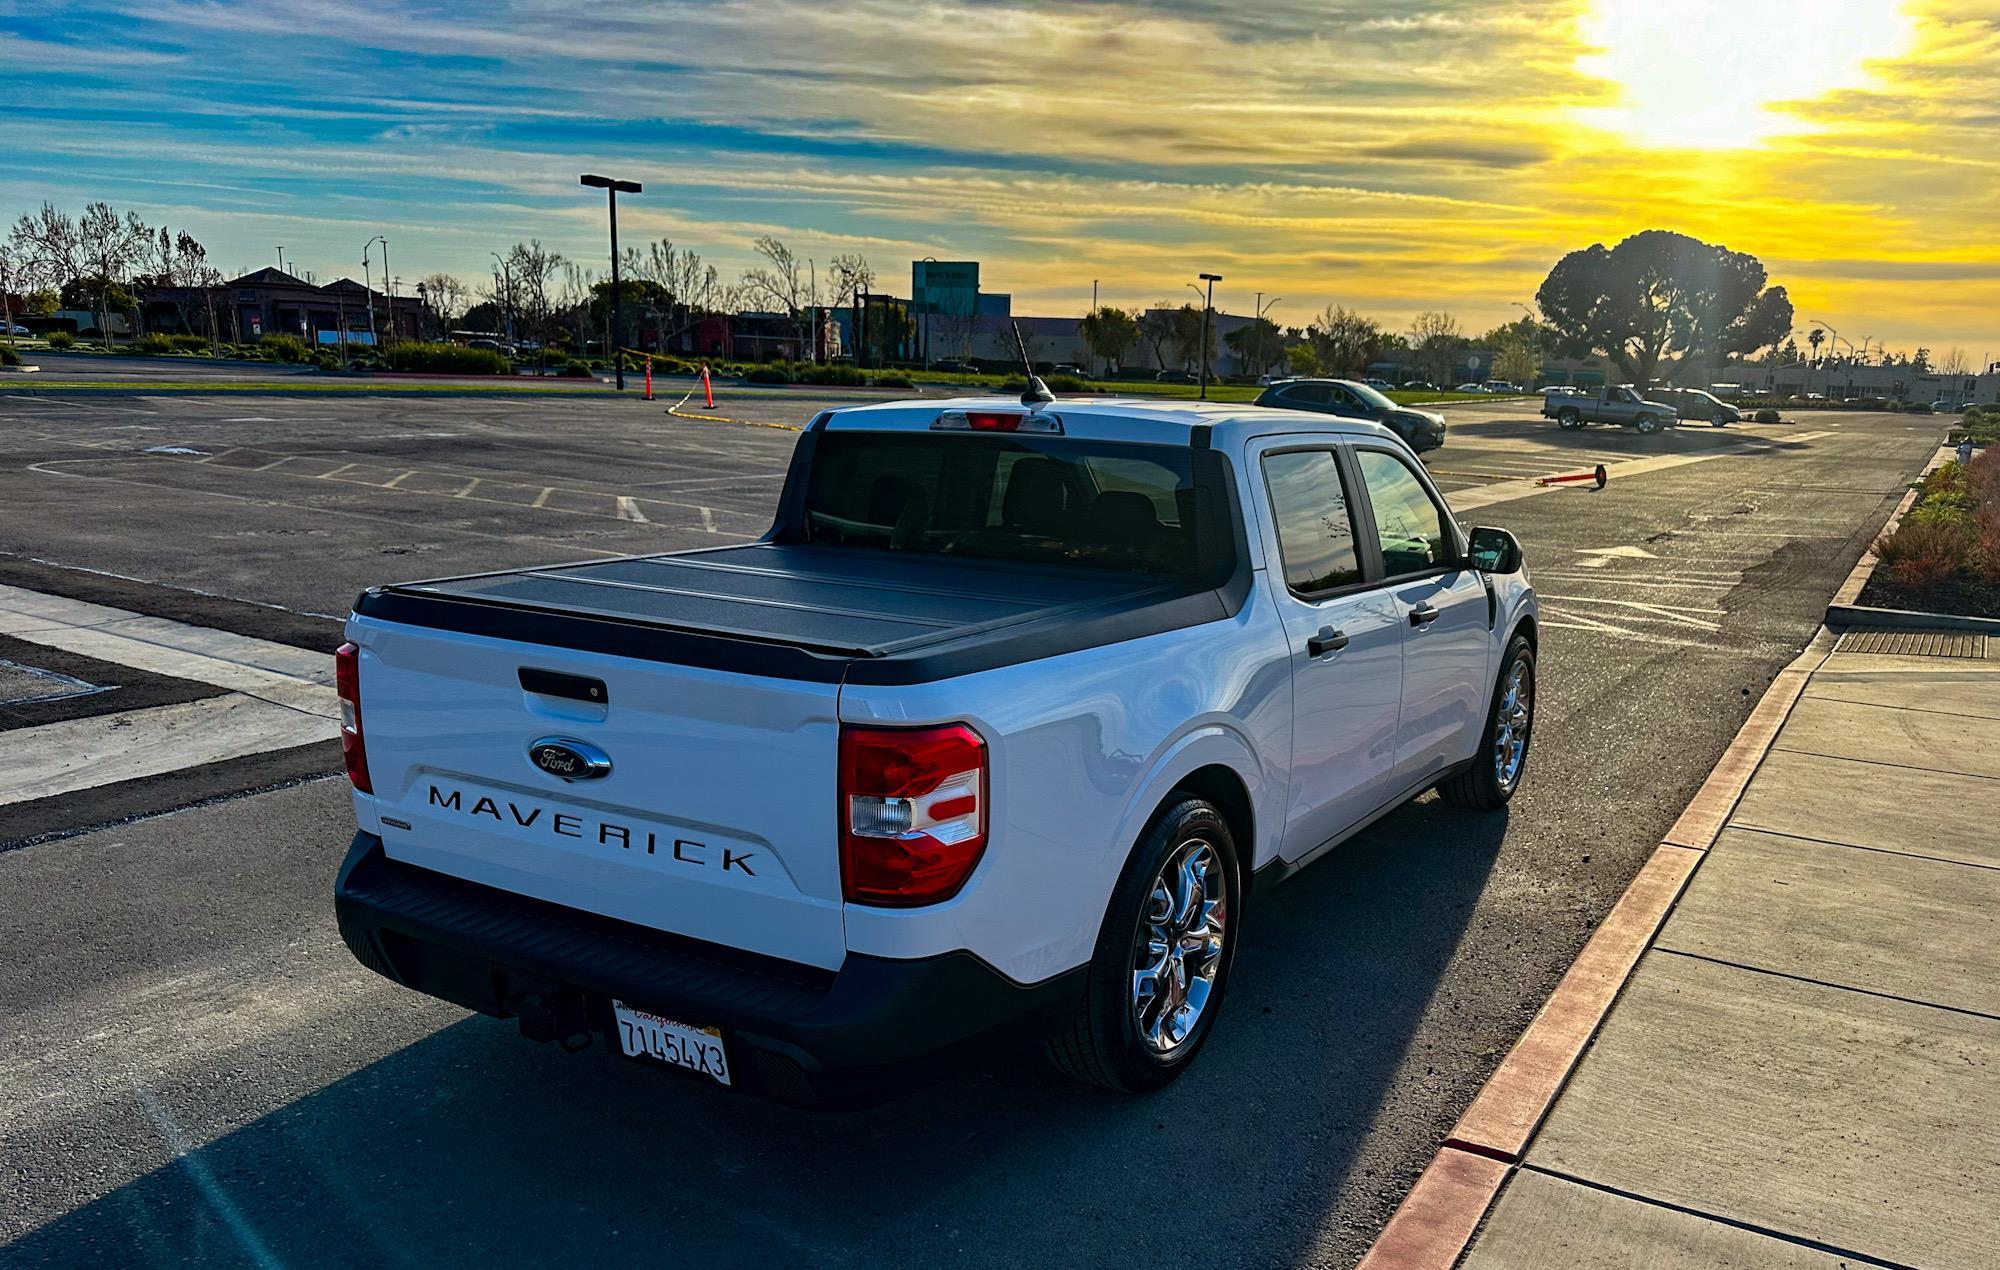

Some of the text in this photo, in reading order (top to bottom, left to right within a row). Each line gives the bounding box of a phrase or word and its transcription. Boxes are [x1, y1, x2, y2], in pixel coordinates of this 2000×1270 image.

[540, 748, 575, 772] Ford
[429, 785, 757, 877] MAVERICK
[620, 1019, 726, 1077] 71454X3
